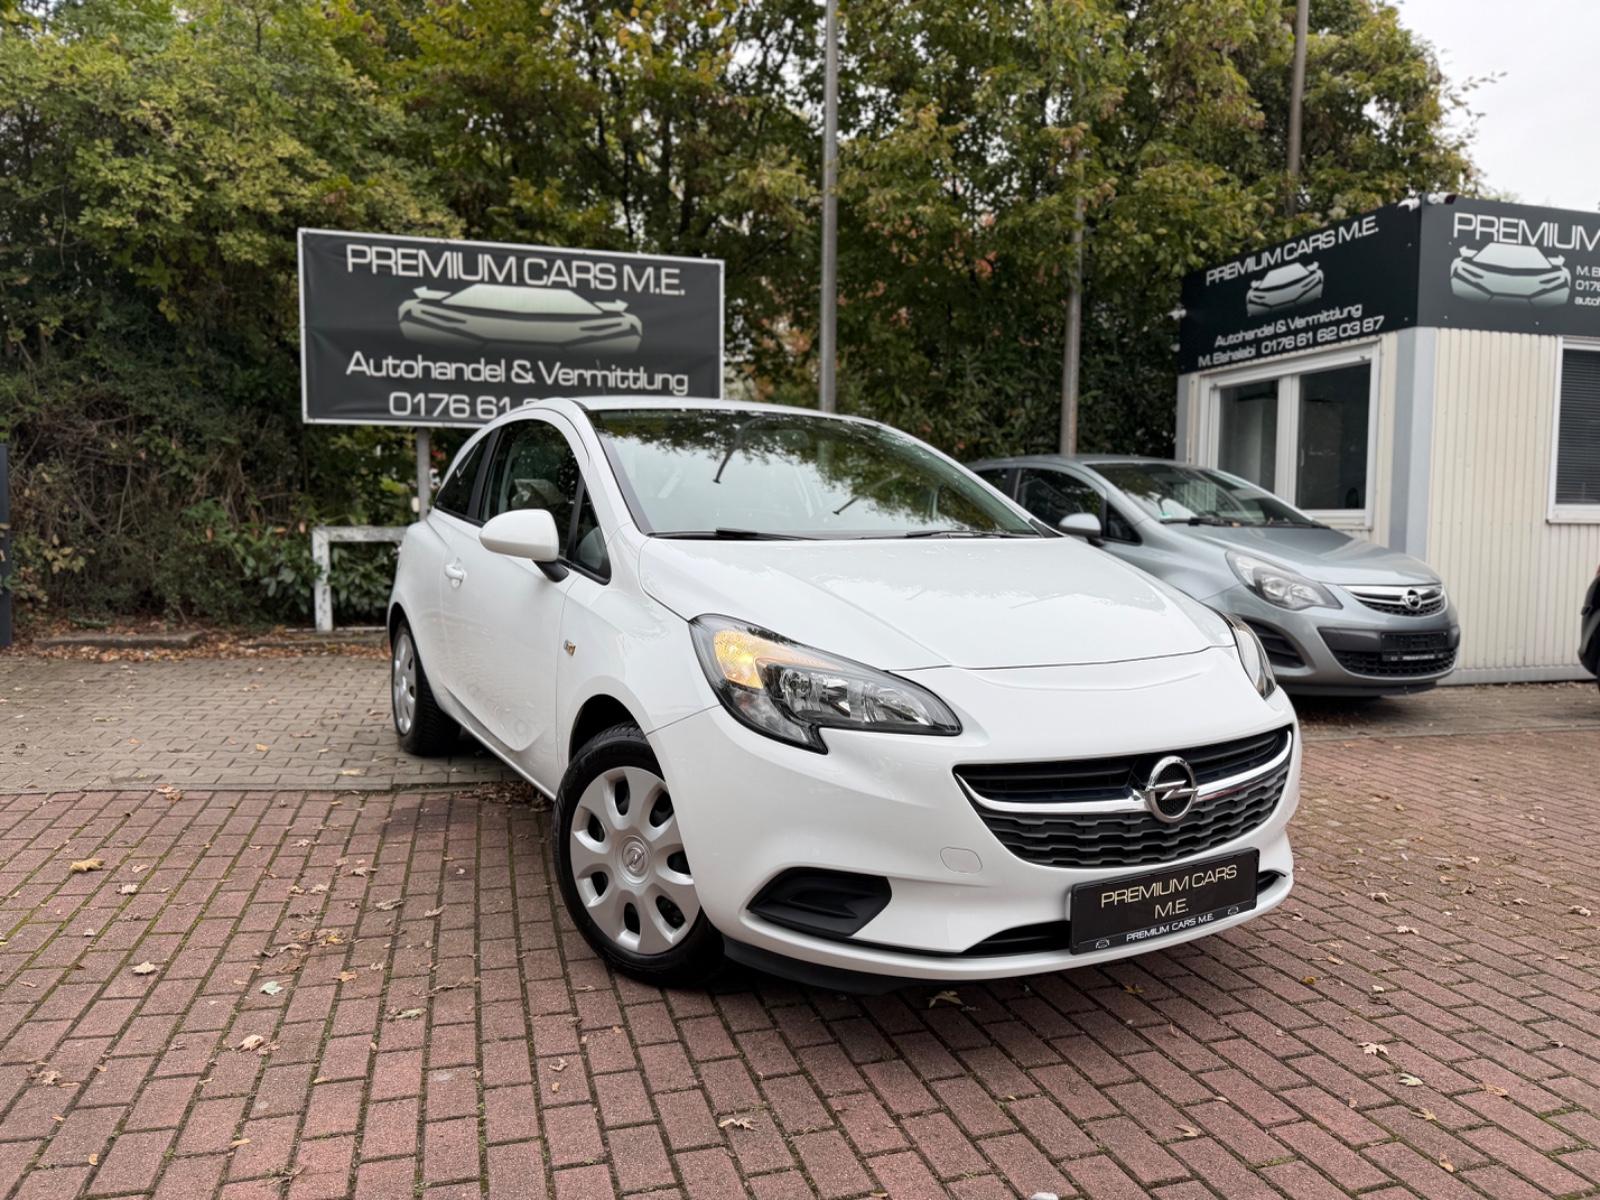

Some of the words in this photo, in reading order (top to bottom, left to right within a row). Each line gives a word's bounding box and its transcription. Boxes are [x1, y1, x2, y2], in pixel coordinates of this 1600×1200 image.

[1206, 247, 1282, 286] PREMIUM
[1283, 229, 1335, 261] CARS
[1338, 215, 1379, 244] M.E.
[1453, 212, 1600, 251] PREMIUM
[346, 244, 517, 284] PREMIUM
[523, 258, 617, 290] CARS
[623, 267, 686, 296] M.E.
[1214, 323, 1275, 348] Autohandel
[1276, 320, 1287, 334] &
[1288, 304, 1363, 330] Vermittlung
[1261, 335, 1295, 354] 0176
[1296, 331, 1313, 347] 61
[1317, 326, 1338, 342] 62
[1338, 321, 1360, 338] 03
[1362, 315, 1385, 332] 87
[346, 350, 506, 383] Autohandel
[511, 361, 535, 384] &
[538, 361, 689, 395] Vermittlung
[389, 391, 470, 419] 0176
[476, 396, 511, 419] 61
[1101, 875, 1189, 908] PREMIUM
[1192, 864, 1237, 888] CARS
[1154, 898, 1189, 919] M.E.
[1126, 925, 1170, 942] PREMIUM
[1171, 918, 1196, 931] CARS
